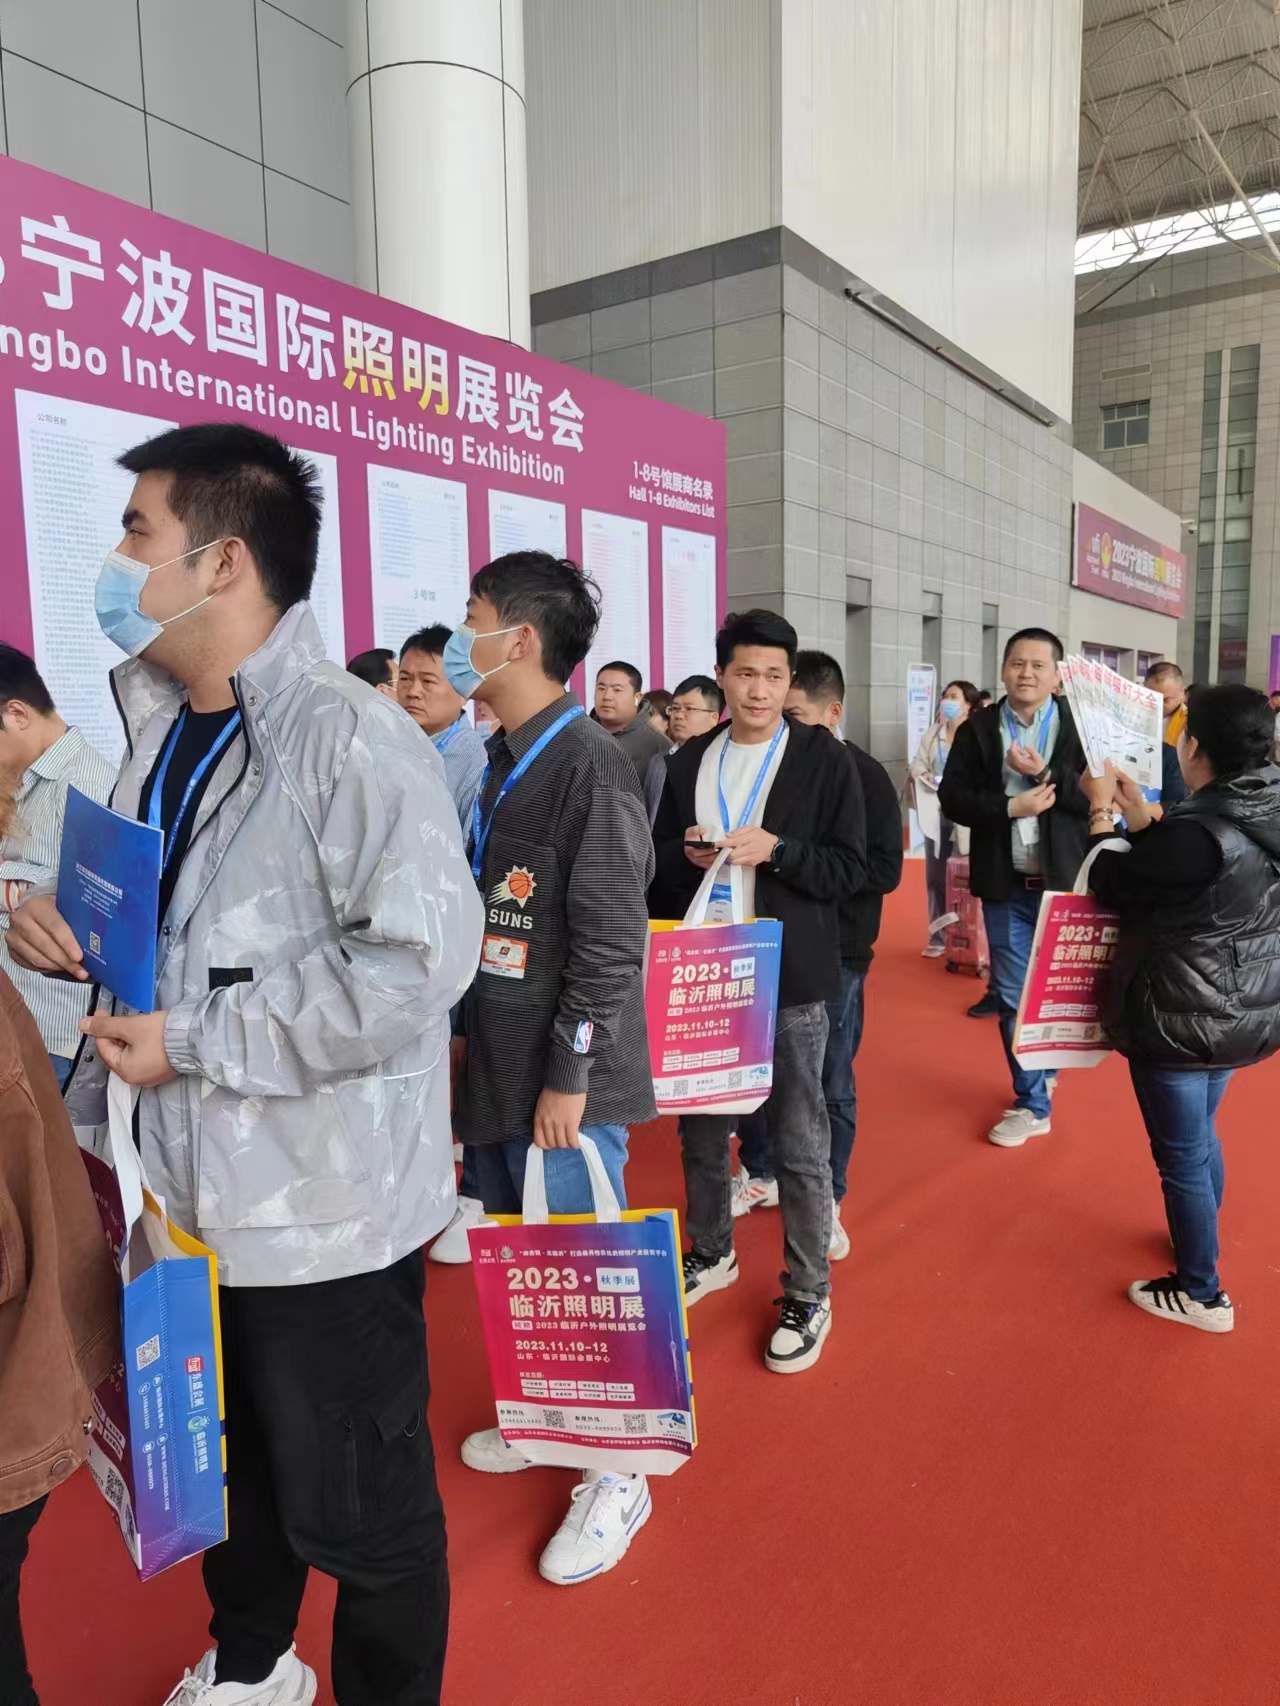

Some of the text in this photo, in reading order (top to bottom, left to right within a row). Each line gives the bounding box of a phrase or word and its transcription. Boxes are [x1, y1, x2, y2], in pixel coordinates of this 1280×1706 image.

[0, 215, 584, 453] 宁波国际照明展览会
[122, 345, 342, 433] International
[351, 406, 453, 465] Lighting
[462, 435, 565, 485] Exhibition
[633, 460, 714, 501] 1-8号馆展商名录
[629, 485, 715, 518] Hall 1-8 Exhibitors List
[488, 908, 533, 930] SUNS
[668, 978, 756, 1006] 临沂照明展
[665, 1018, 730, 1033] 2023.11.10-12
[600, 1274, 636, 1286] 秋季展
[509, 1294, 645, 1319] 临沂照明展
[535, 1321, 558, 1330] 2023
[515, 1339, 608, 1353] 2023.11.10-12
